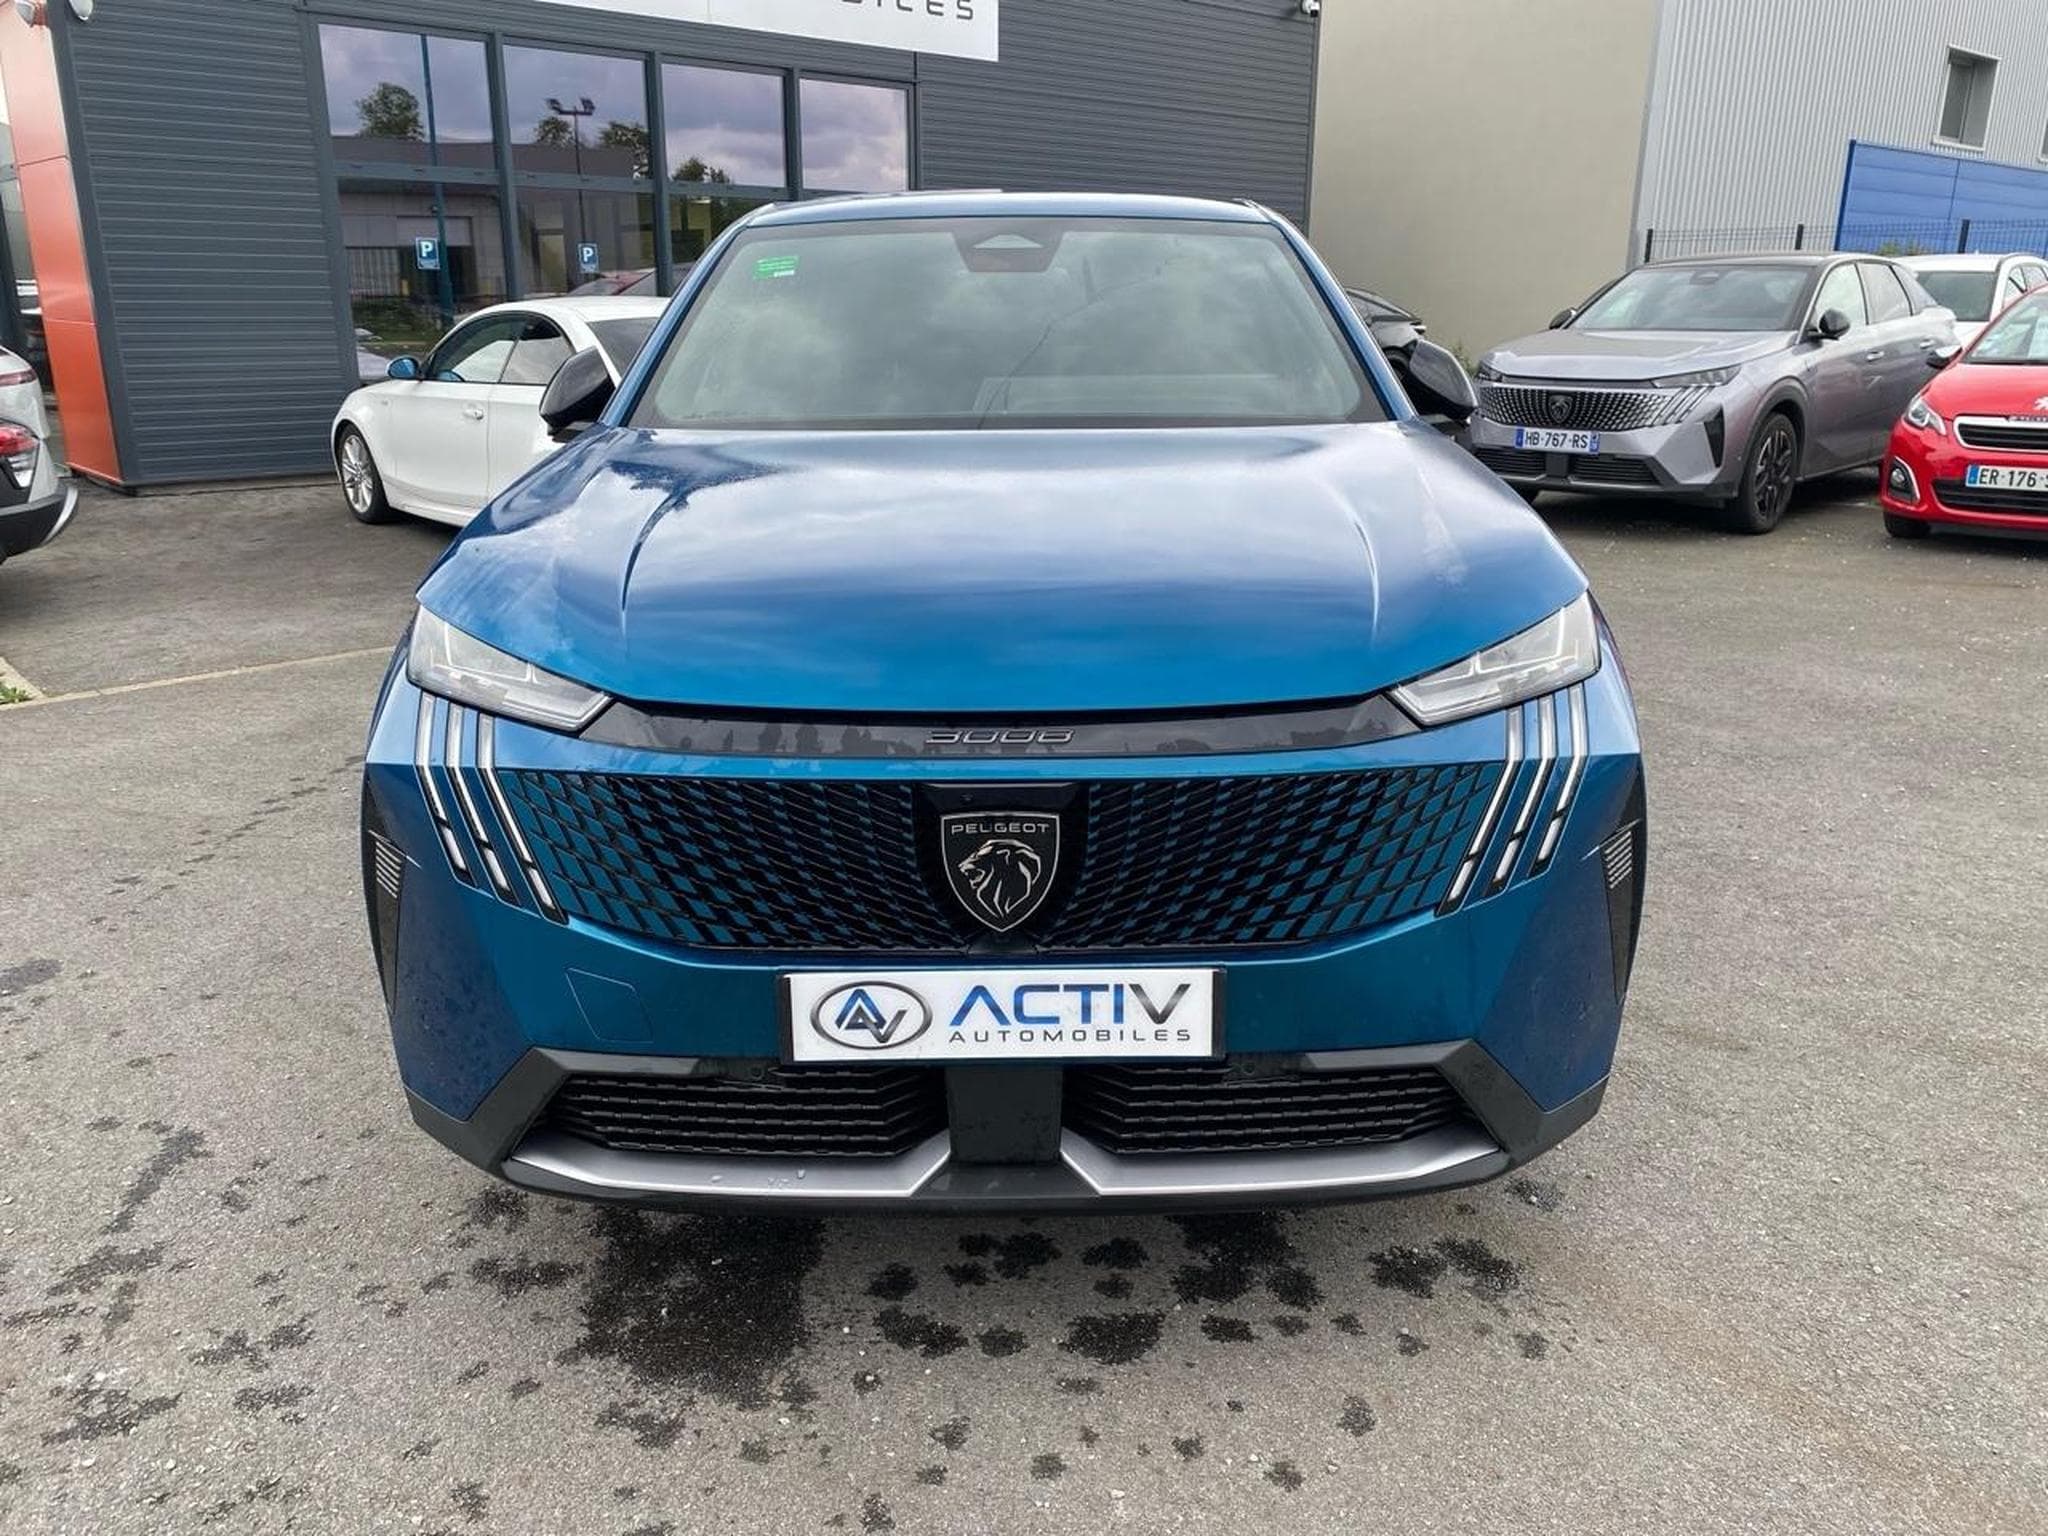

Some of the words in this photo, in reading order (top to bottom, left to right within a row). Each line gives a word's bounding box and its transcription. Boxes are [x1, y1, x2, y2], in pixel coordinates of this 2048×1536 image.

[841, 0, 974, 20] LES
[420, 241, 434, 257] P
[583, 247, 594, 263] P
[925, 728, 1075, 744] 3008
[951, 823, 1050, 835] PEUGEOT
[949, 983, 1191, 1025] ACTIV
[949, 1029, 1191, 1043] AUTOMOBILES
